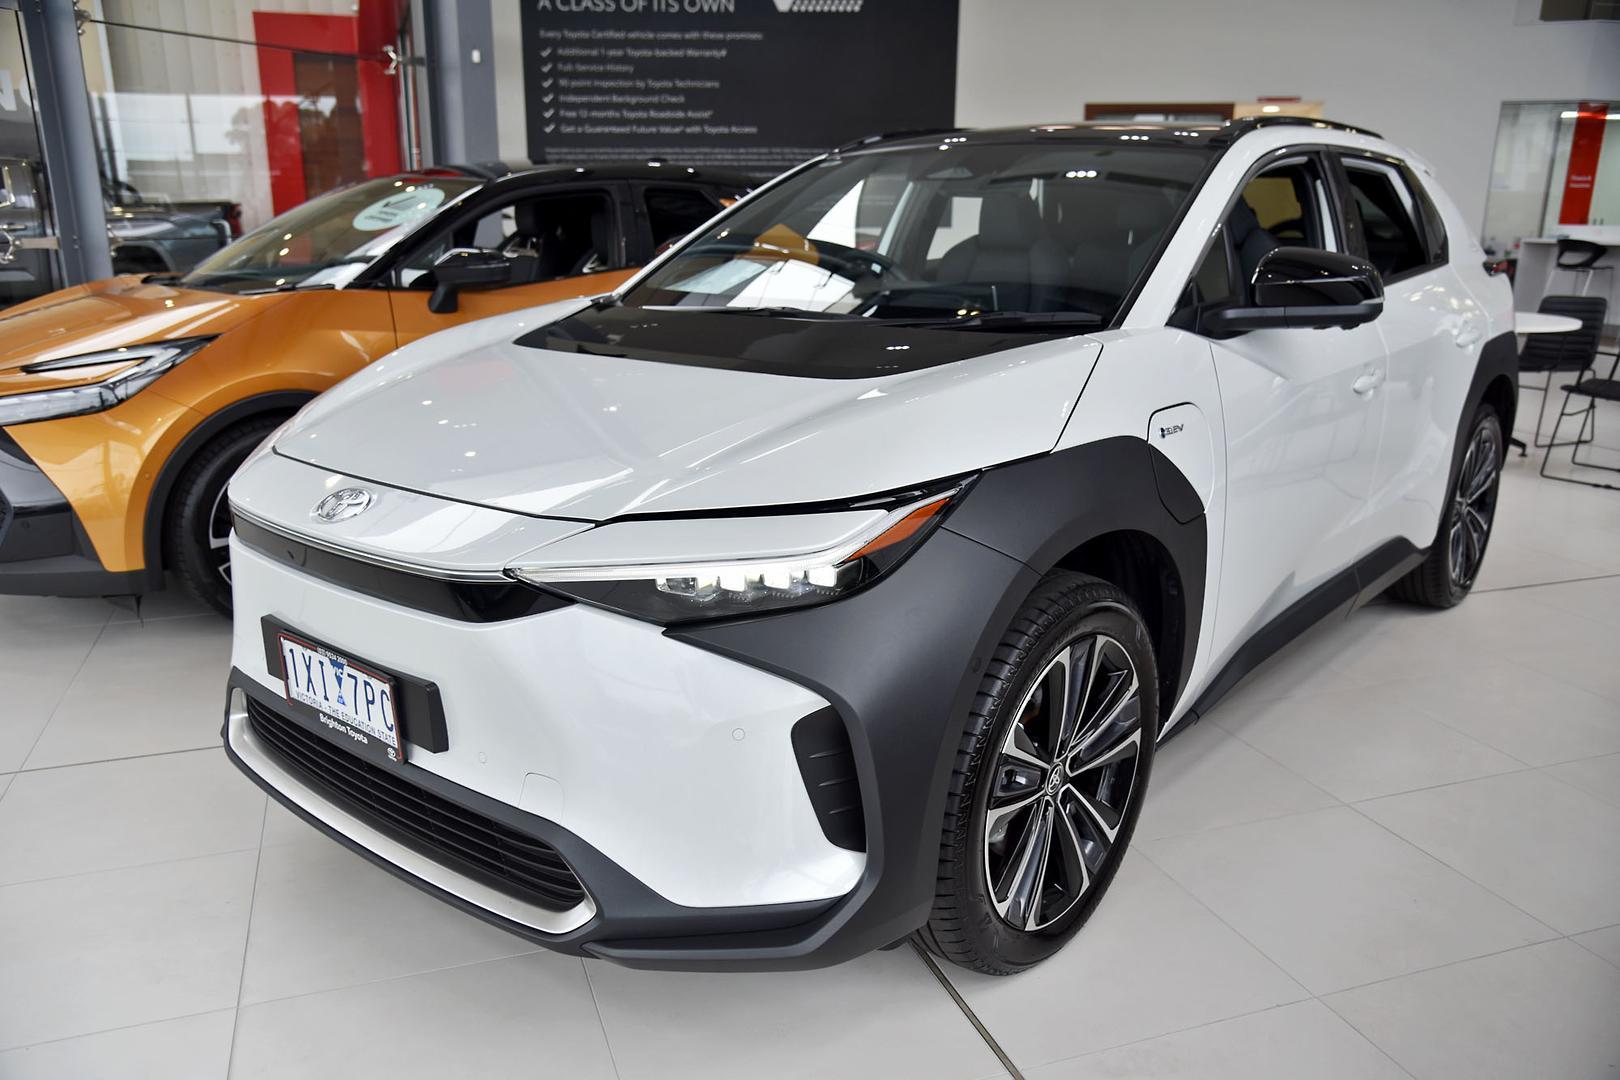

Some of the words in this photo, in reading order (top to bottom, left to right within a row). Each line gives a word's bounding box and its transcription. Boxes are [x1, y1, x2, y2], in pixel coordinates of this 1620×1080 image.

[537, 0, 552, 11] A
[555, 0, 616, 12] CLASS
[620, 0, 647, 12] OF
[653, 0, 680, 13] ITS
[683, 0, 735, 13] OWN
[563, 29, 590, 40] Toyota
[591, 29, 626, 40] Certified
[627, 30, 655, 40] vehicle
[557, 48, 598, 57] Additional
[575, 63, 604, 72] Service
[647, 79, 673, 90] Toyota
[674, 79, 720, 89] Technicians
[559, 94, 611, 105] Independent
[612, 94, 659, 106] Background
[660, 94, 685, 104] Check
[622, 109, 648, 120] Toyota
[649, 110, 685, 119] Roadside
[560, 125, 576, 134] Get
[584, 124, 631, 134] Guaranteed
[632, 125, 658, 134] Future
[685, 125, 702, 134] with
[704, 124, 730, 136] Toyota
[731, 125, 758, 135] Access
[289, 648, 329, 702] 1XI
[347, 673, 394, 732] 7PC
[296, 691, 323, 708] VICTORIA
[328, 704, 340, 717] THE
[341, 711, 376, 735] EDUCATION
[377, 728, 396, 746] STATE
[320, 713, 347, 733] Brighton
[346, 726, 369, 744] Toyota
